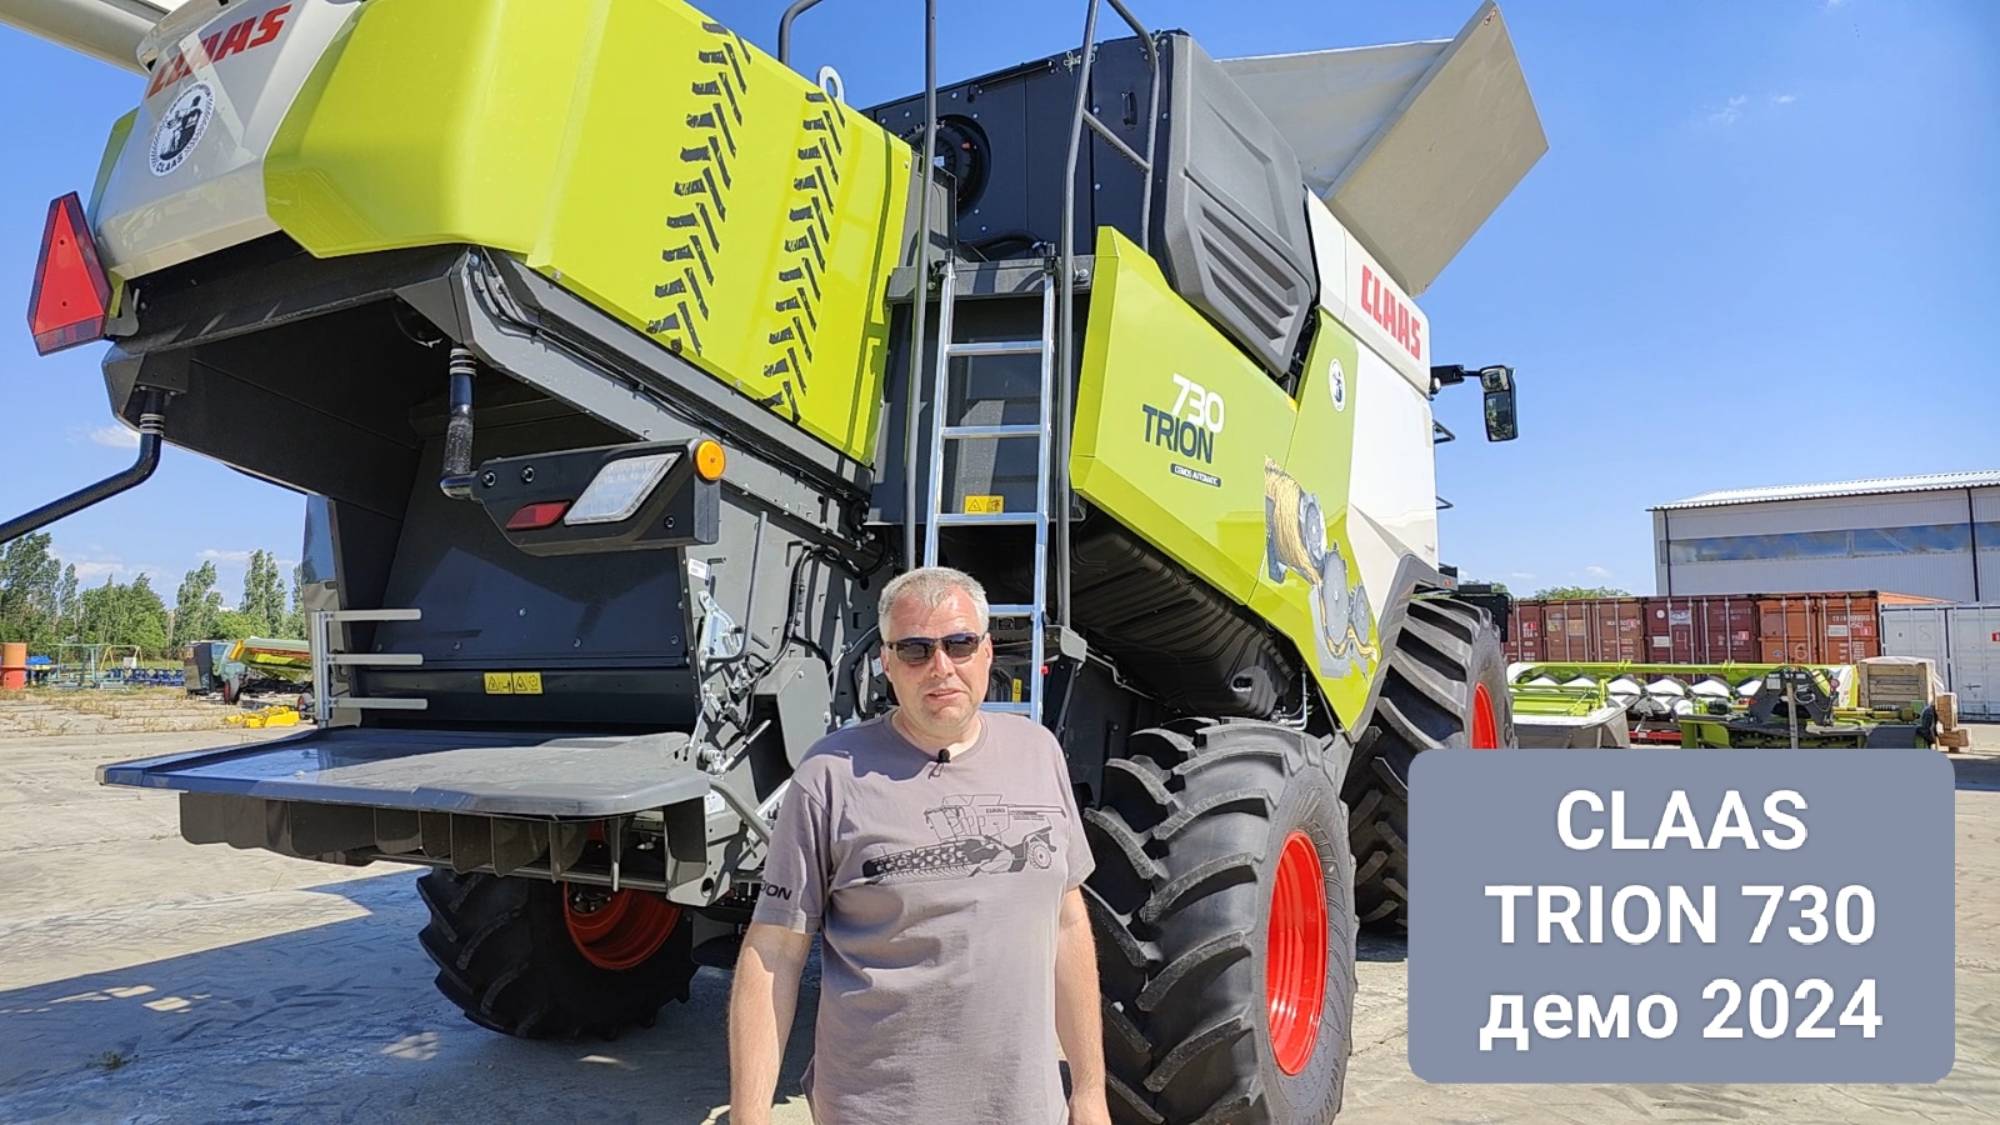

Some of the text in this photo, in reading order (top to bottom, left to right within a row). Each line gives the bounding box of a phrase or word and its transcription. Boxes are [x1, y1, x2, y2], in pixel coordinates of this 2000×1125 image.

[1361, 264, 1421, 361] CLAAS
[1142, 403, 1214, 464] TRION
[1172, 373, 1225, 433] 730
